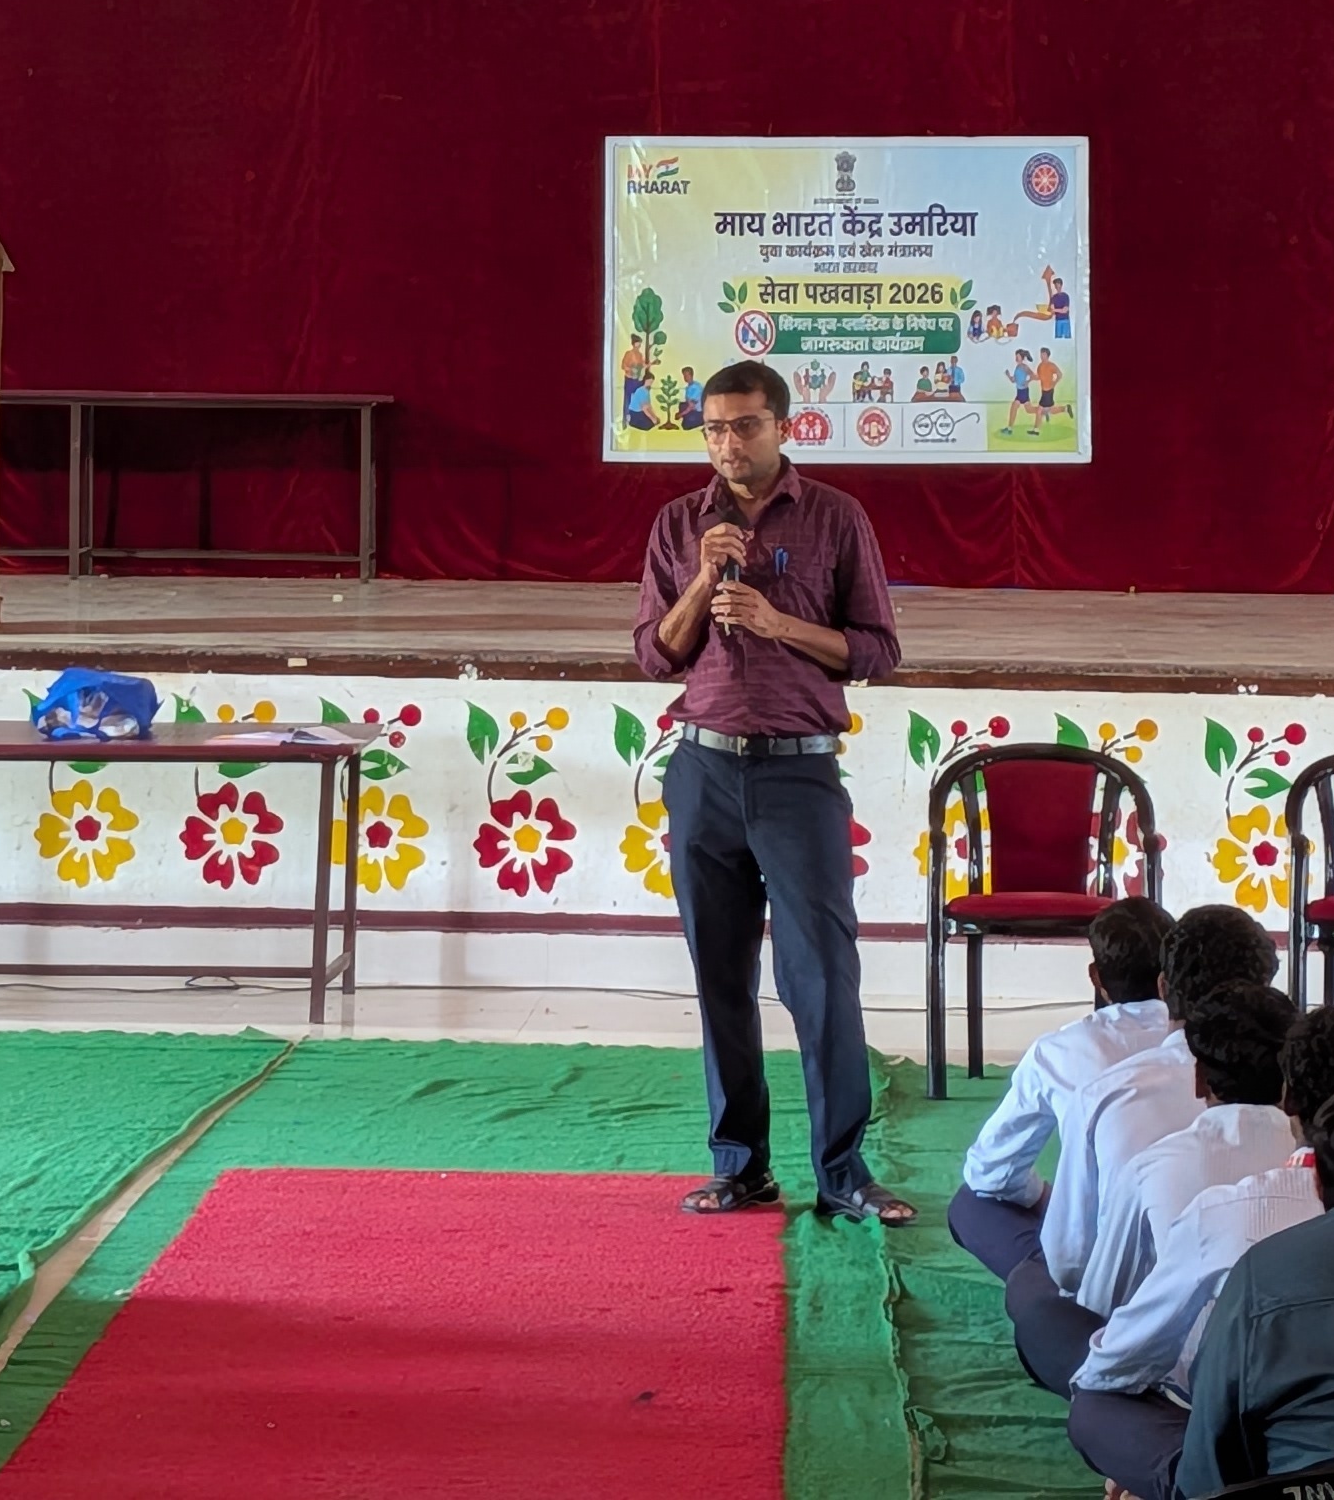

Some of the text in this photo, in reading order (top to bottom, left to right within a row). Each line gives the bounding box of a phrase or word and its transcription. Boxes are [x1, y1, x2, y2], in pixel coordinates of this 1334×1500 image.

[628, 180, 691, 194] BHARAT
[714, 202, 979, 239] माय भारत केंद्र उमरिया
[758, 277, 944, 311] सेवा पखवाड़ा 2026
